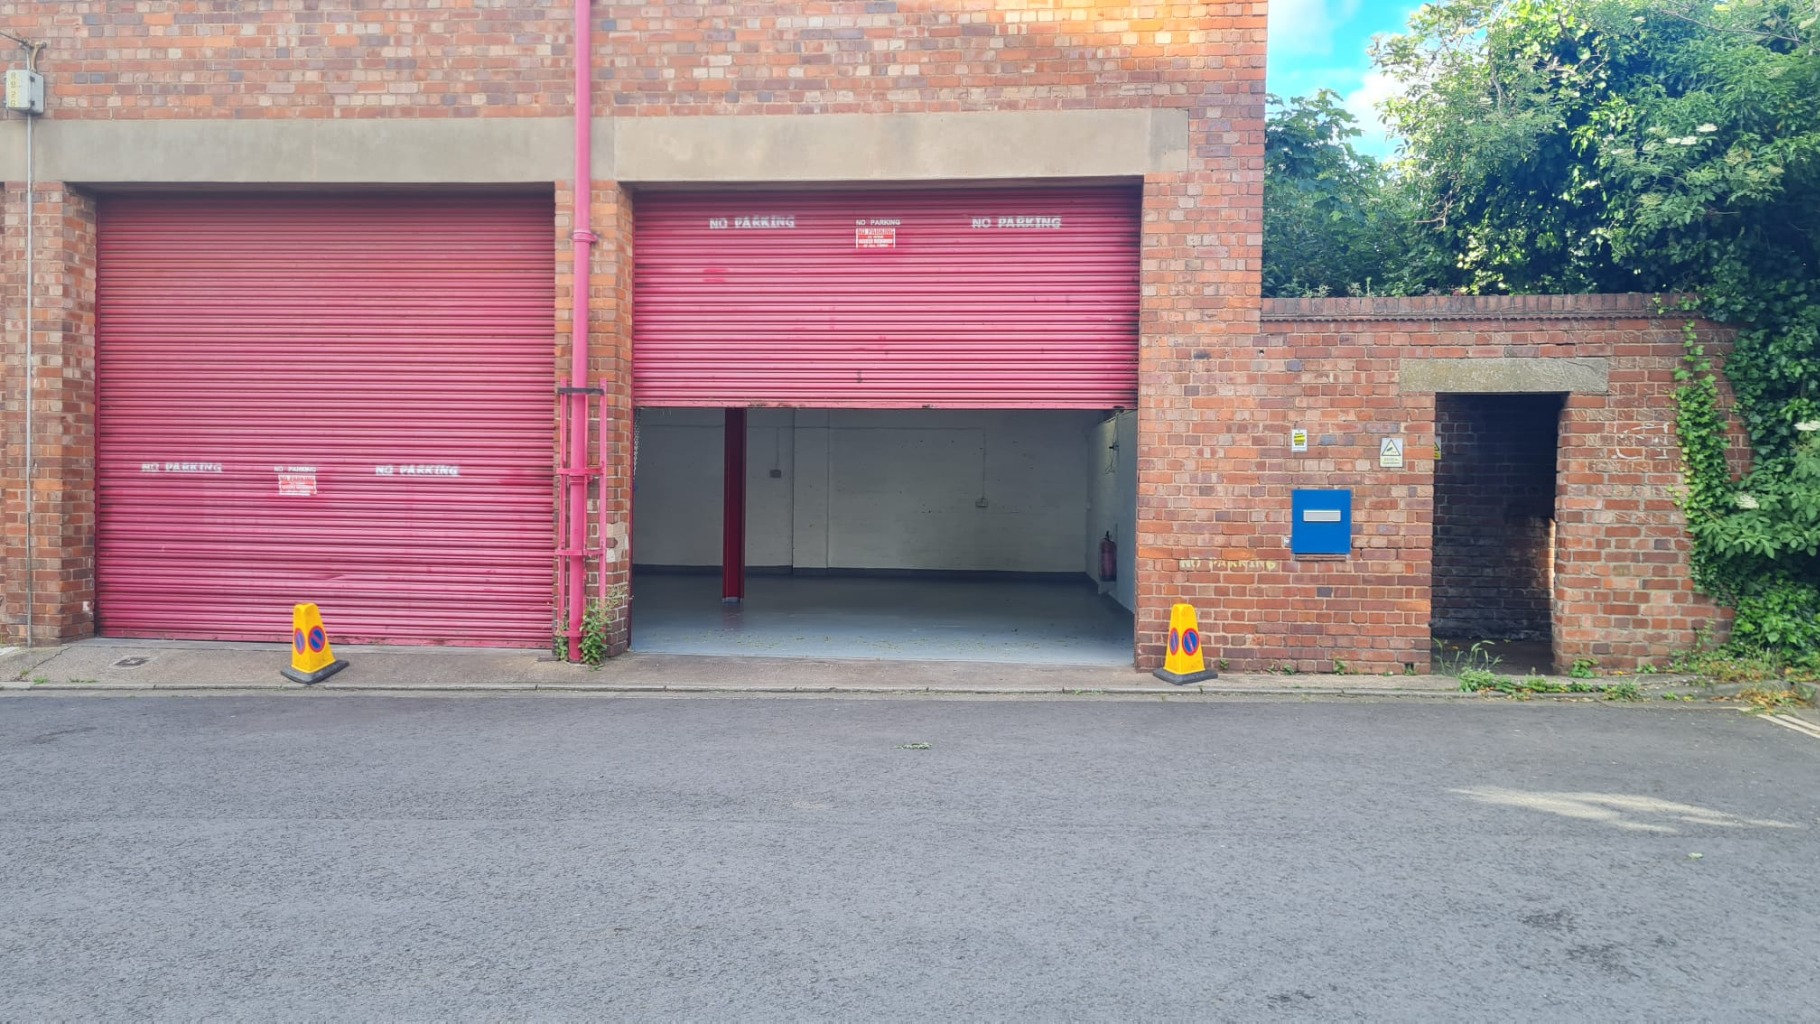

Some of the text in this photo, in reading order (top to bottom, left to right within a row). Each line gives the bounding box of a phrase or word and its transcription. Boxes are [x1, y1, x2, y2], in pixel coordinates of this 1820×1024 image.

[709, 216, 796, 229] NO PARKING
[972, 216, 1062, 229] NO PARKING
[141, 462, 224, 474] NO PARKING
[375, 464, 461, 477] NO PARKING
[1180, 556, 1277, 570] NO PARKING
